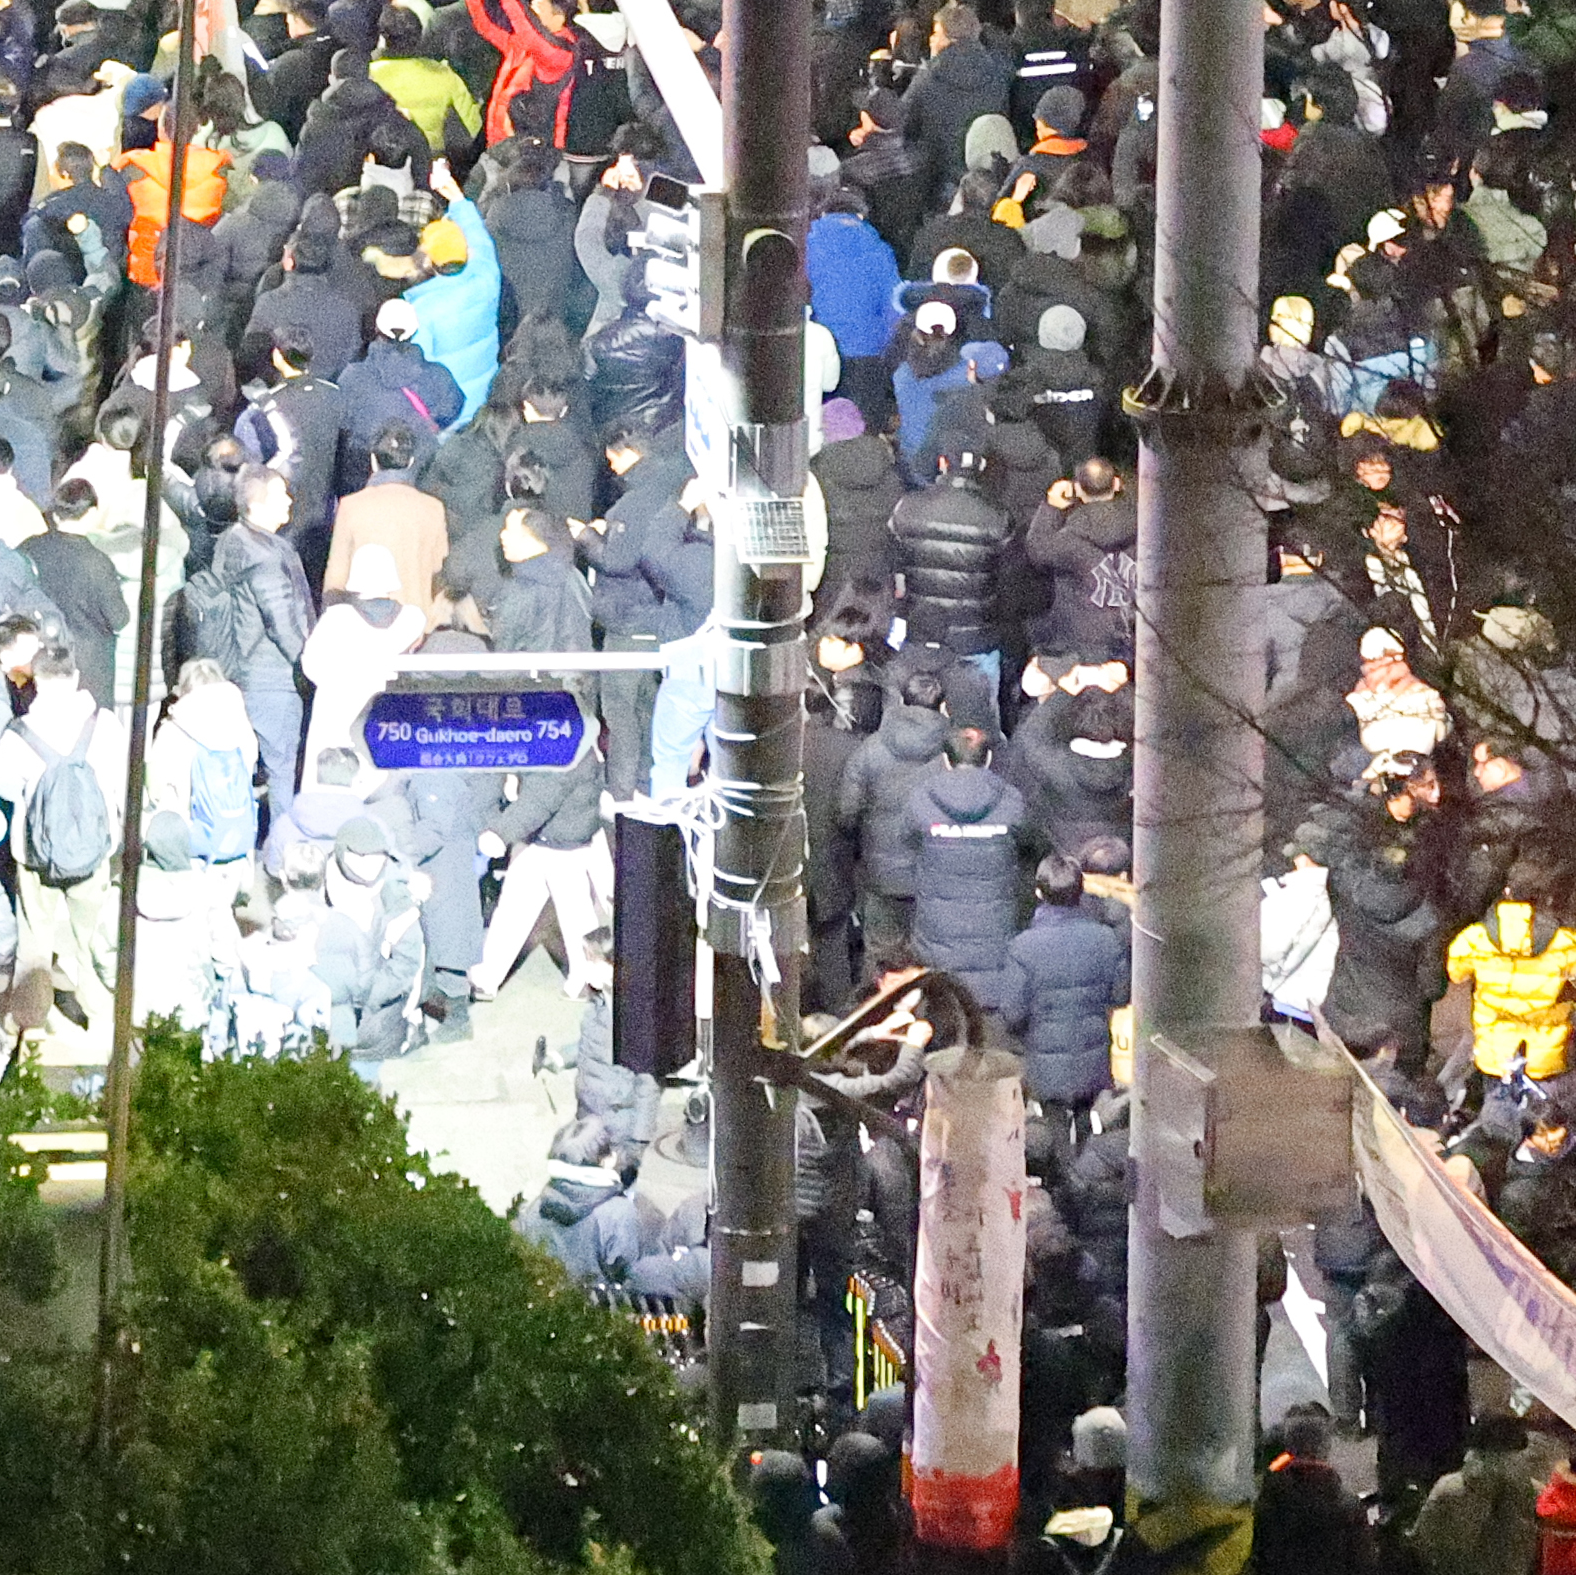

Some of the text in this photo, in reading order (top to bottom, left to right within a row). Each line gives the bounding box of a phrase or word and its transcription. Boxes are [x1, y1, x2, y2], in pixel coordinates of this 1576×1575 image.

[377, 720, 573, 744] 750 Gukhoe-daero 754
